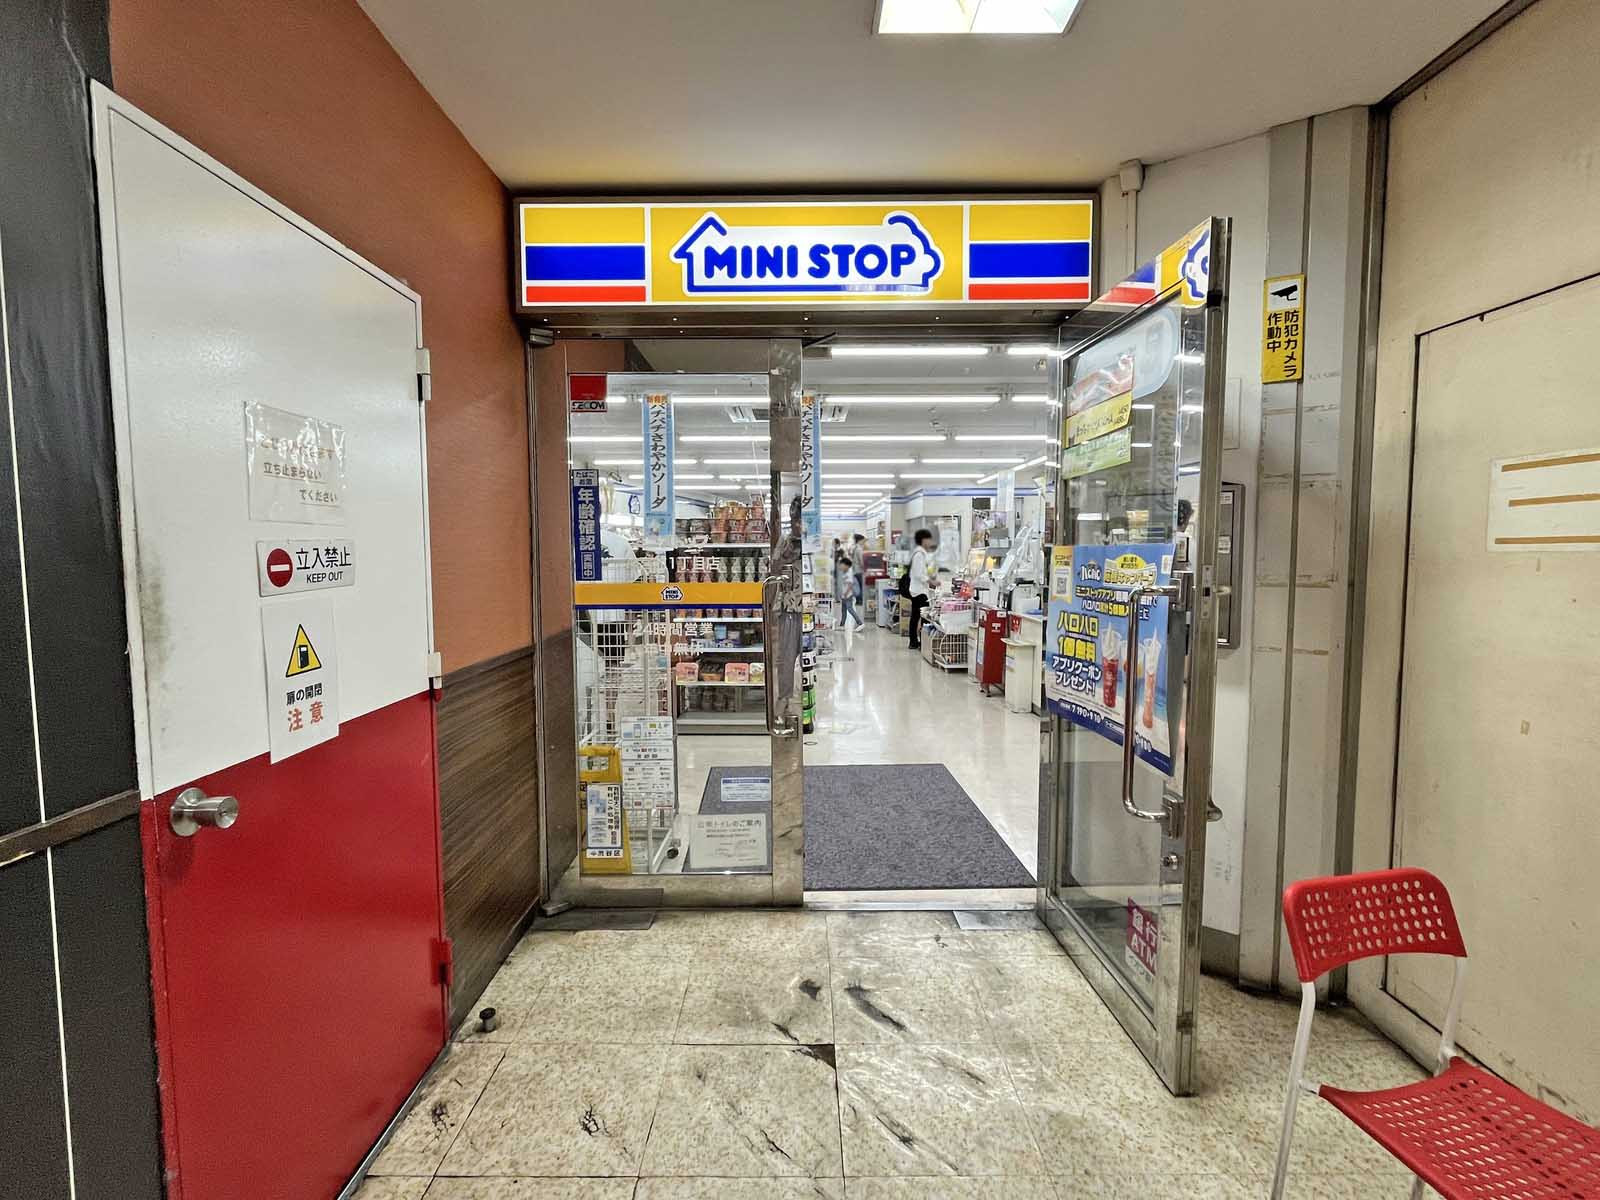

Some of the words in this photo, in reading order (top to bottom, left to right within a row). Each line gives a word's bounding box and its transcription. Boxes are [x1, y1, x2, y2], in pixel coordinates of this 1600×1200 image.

[704, 244, 799, 279] MINI
[807, 243, 916, 279] STOP
[1266, 312, 1283, 353] 作動中
[1283, 309, 1300, 378] 防犯カメラ
[572, 401, 605, 410] SECOM
[577, 487, 596, 551] 年齢確認
[295, 546, 352, 571] 立入禁止
[668, 555, 721, 571] 1丁目店
[306, 572, 327, 584] KEEP
[328, 571, 344, 582] OUT
[631, 621, 714, 637] 24時間営業
[1057, 610, 1099, 638] ハロハロ
[1052, 655, 1103, 681] アプリクーポン
[286, 682, 323, 706] 扉の開閉
[287, 701, 324, 733] 注意
[1130, 932, 1158, 974] ATM
